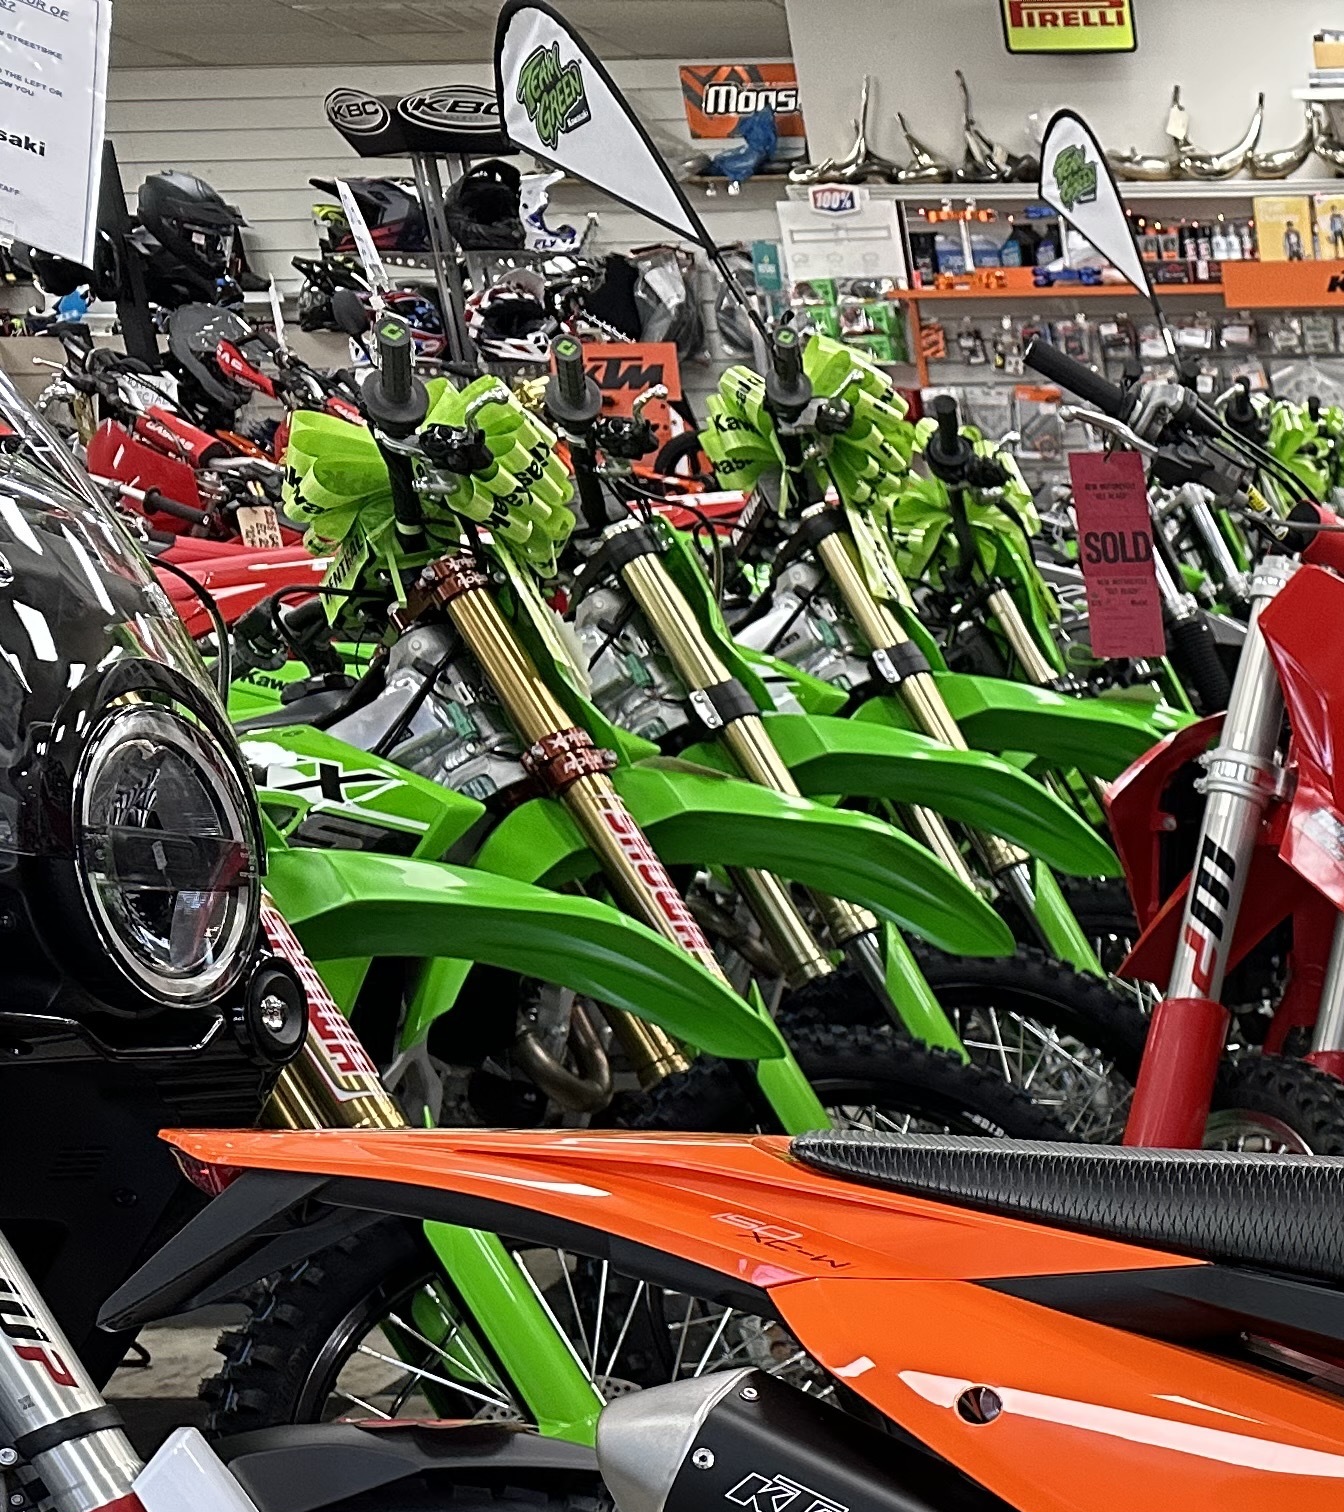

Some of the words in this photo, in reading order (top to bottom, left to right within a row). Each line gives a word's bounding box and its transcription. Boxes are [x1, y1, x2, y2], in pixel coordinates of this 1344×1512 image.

[1008, 0, 1125, 28] PIRELLI
[517, 41, 561, 121] TEAM
[331, 101, 380, 121] KBC
[535, 60, 584, 149] GREEN
[814, 190, 852, 209] 100%
[584, 356, 665, 390] KTM
[1084, 530, 1152, 565] SOLD
[709, 1212, 804, 1242] 150
[735, 1230, 852, 1269] XC-W
